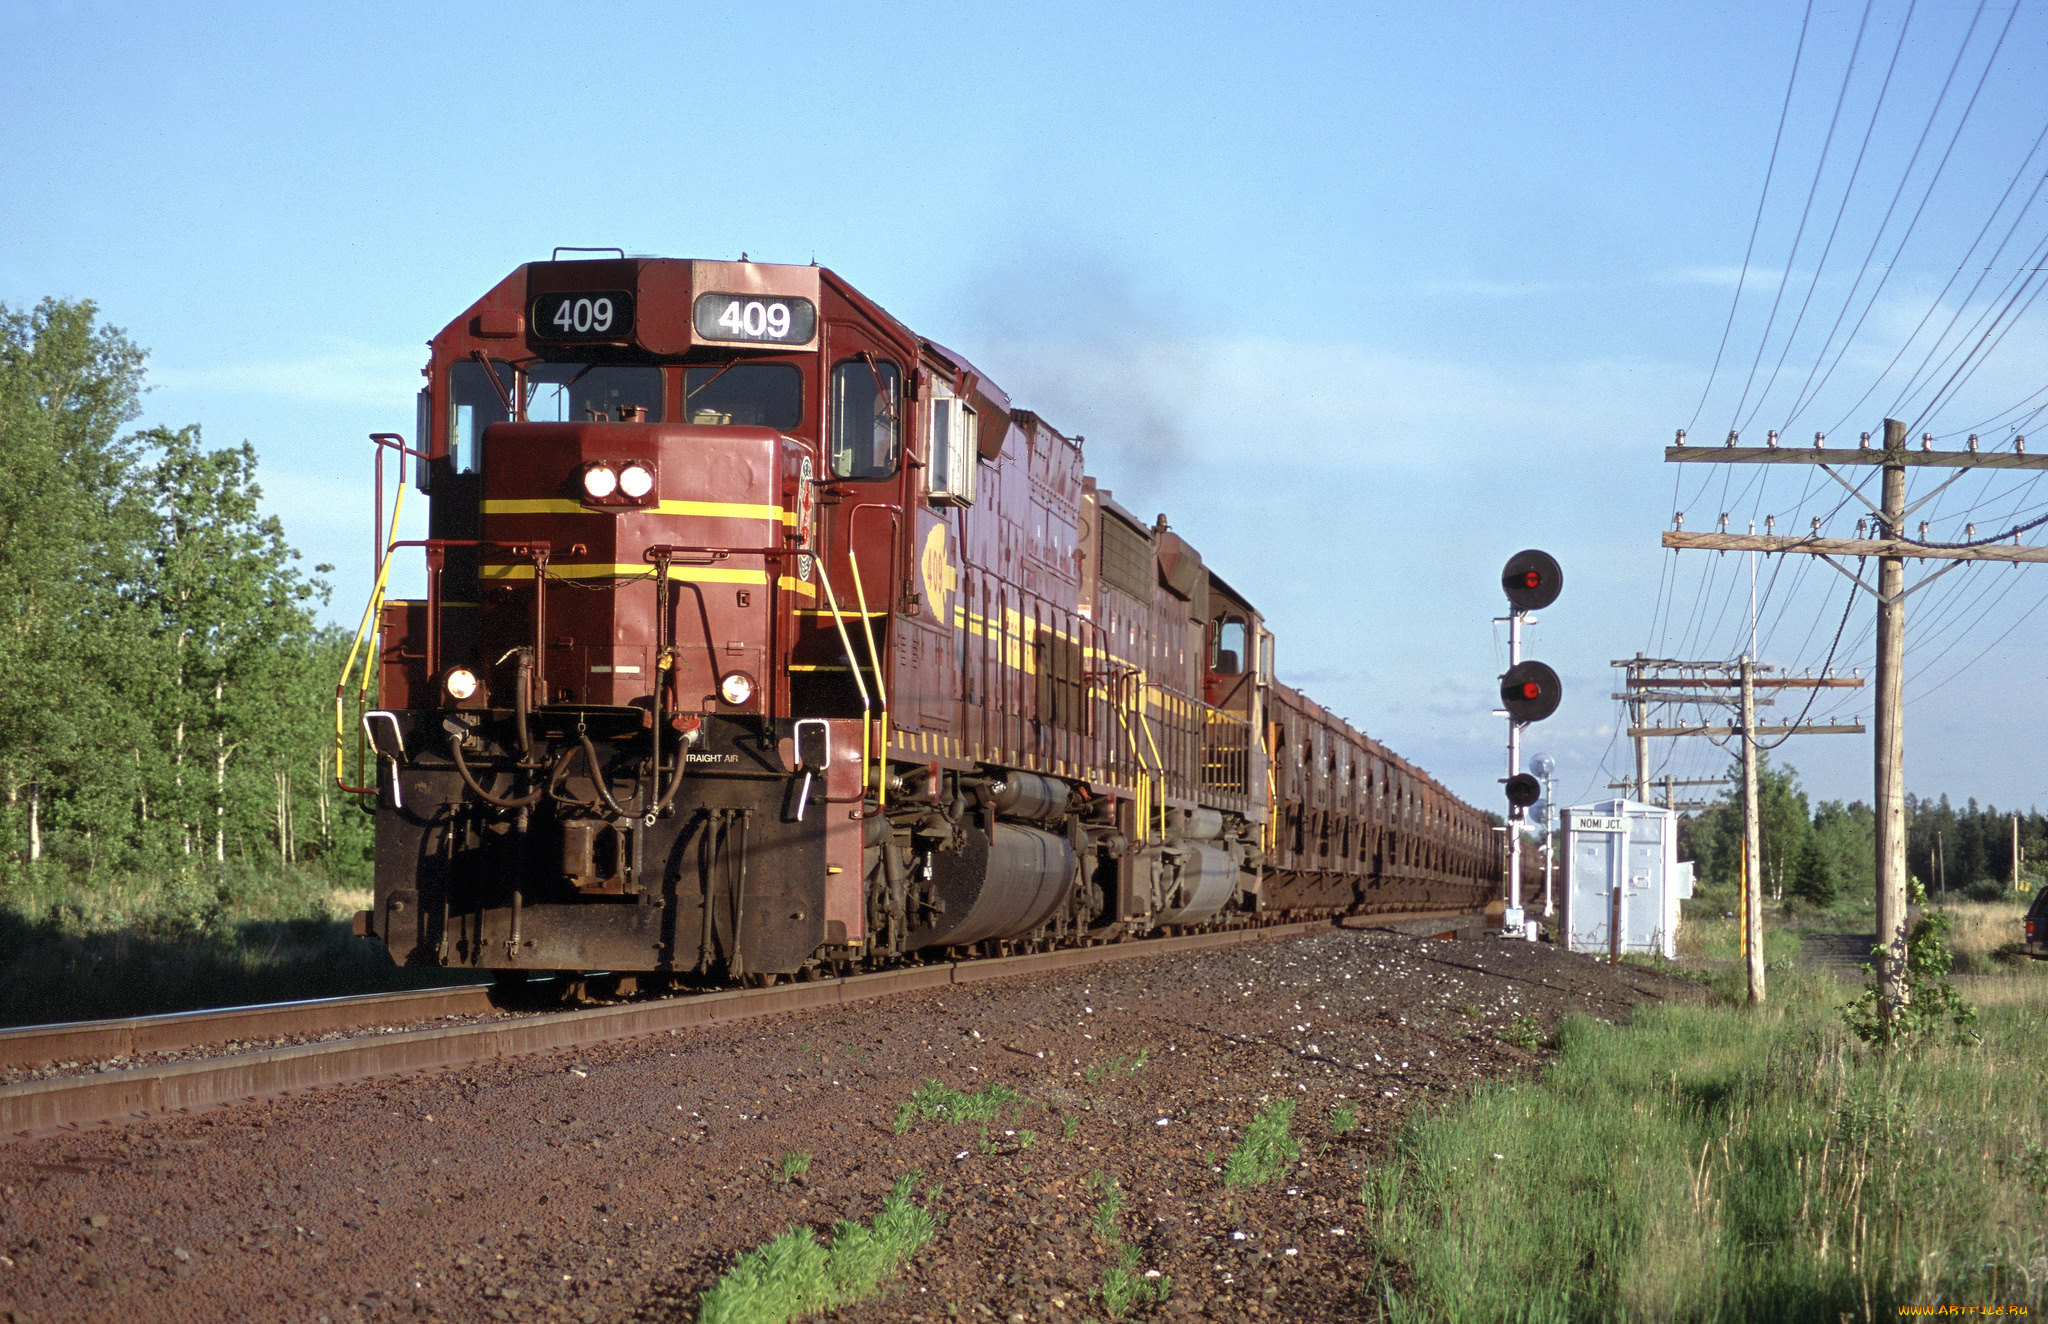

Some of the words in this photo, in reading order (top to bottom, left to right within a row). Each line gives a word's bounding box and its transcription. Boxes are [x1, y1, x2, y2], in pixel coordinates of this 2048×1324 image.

[553, 298, 613, 332] 409
[718, 301, 791, 338] 409
[927, 547, 943, 594] 409
[685, 754, 722, 763] TRAIGHT
[723, 755, 739, 763] AIR
[1580, 818, 1602, 829] NOMI
[1605, 819, 1623, 830] JCT.
